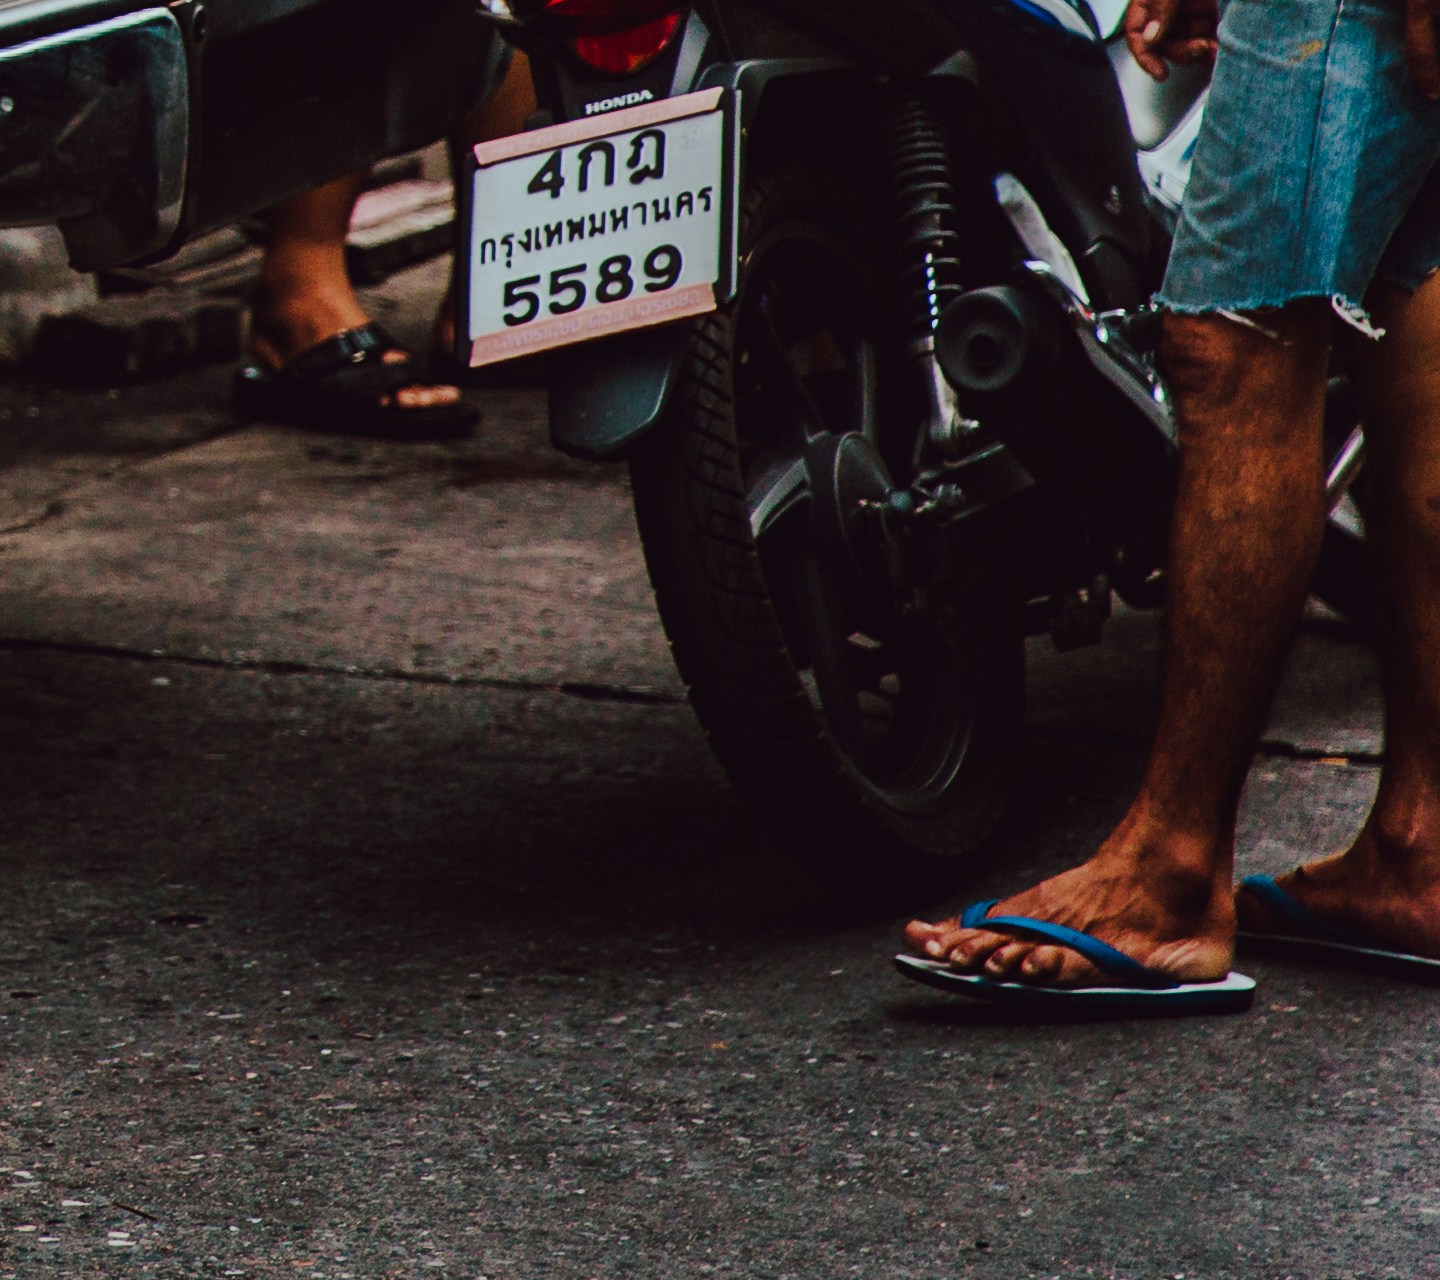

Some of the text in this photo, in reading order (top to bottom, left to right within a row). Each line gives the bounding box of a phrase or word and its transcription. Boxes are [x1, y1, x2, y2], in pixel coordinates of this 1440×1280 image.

[585, 89, 654, 115] HONDA
[480, 186, 713, 269] กรุงเทพมหานคร
[502, 243, 683, 327] 5589
